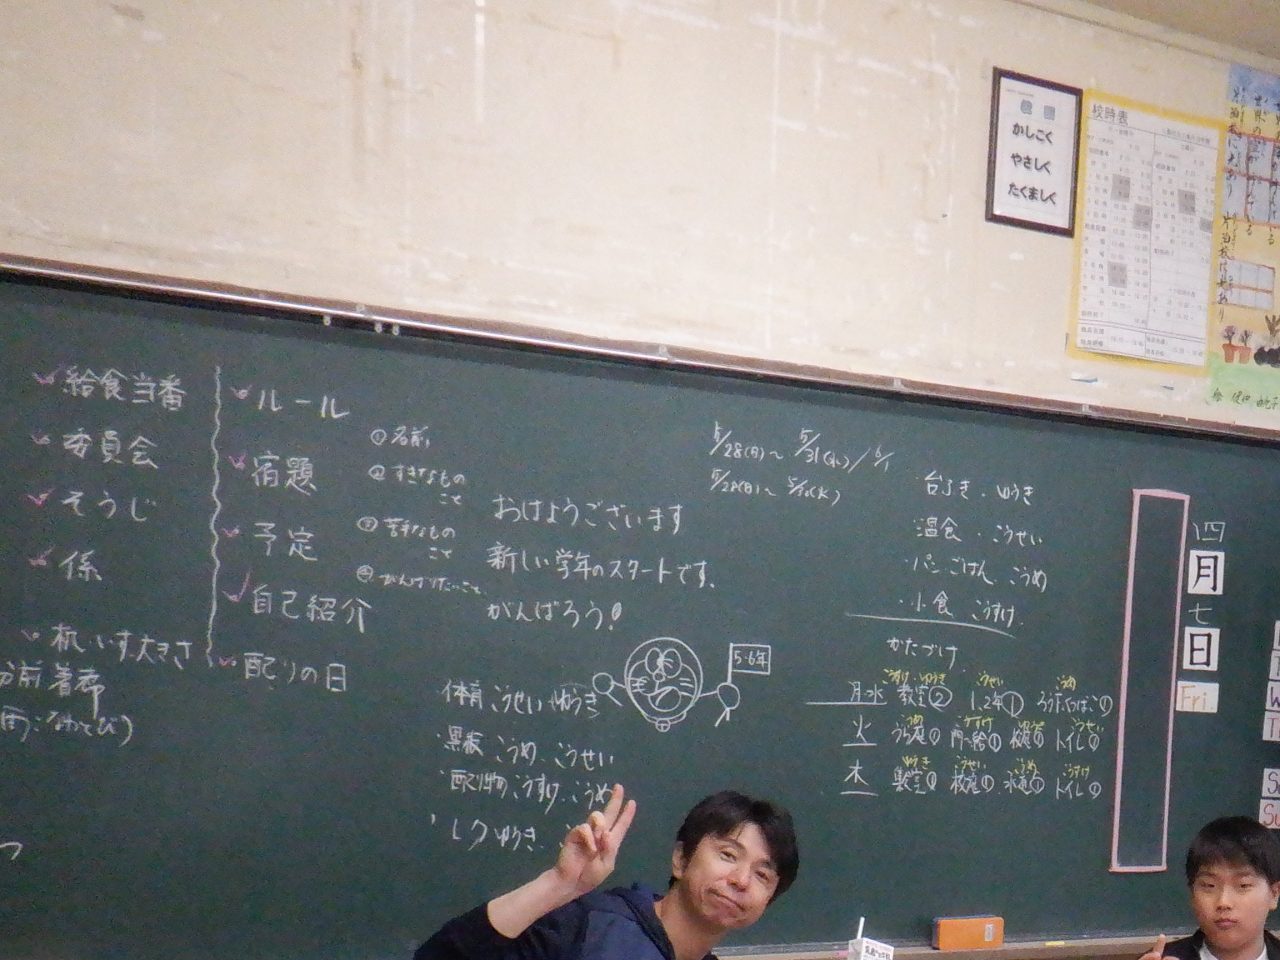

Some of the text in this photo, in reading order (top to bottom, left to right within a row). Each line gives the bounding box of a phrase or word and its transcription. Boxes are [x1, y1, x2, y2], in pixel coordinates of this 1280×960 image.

[1012, 122, 1053, 144] かしこく
[1011, 152, 1051, 175] やさしく
[1008, 182, 1056, 206] たくましく
[62, 367, 187, 411] 給食当番
[258, 389, 350, 418] ルール
[63, 428, 159, 469] 委員会
[252, 451, 318, 495] 宿題
[62, 491, 156, 522] そうじ
[492, 494, 684, 535] おはようございます
[253, 522, 318, 561] 予定
[58, 550, 102, 581] 係
[252, 584, 373, 633] 自己紹介
[887, 637, 958, 670] かたづけ
[243, 652, 347, 692] 配りの日
[441, 680, 483, 710] 体育
[853, 714, 872, 744] 火
[843, 758, 869, 786] 木
